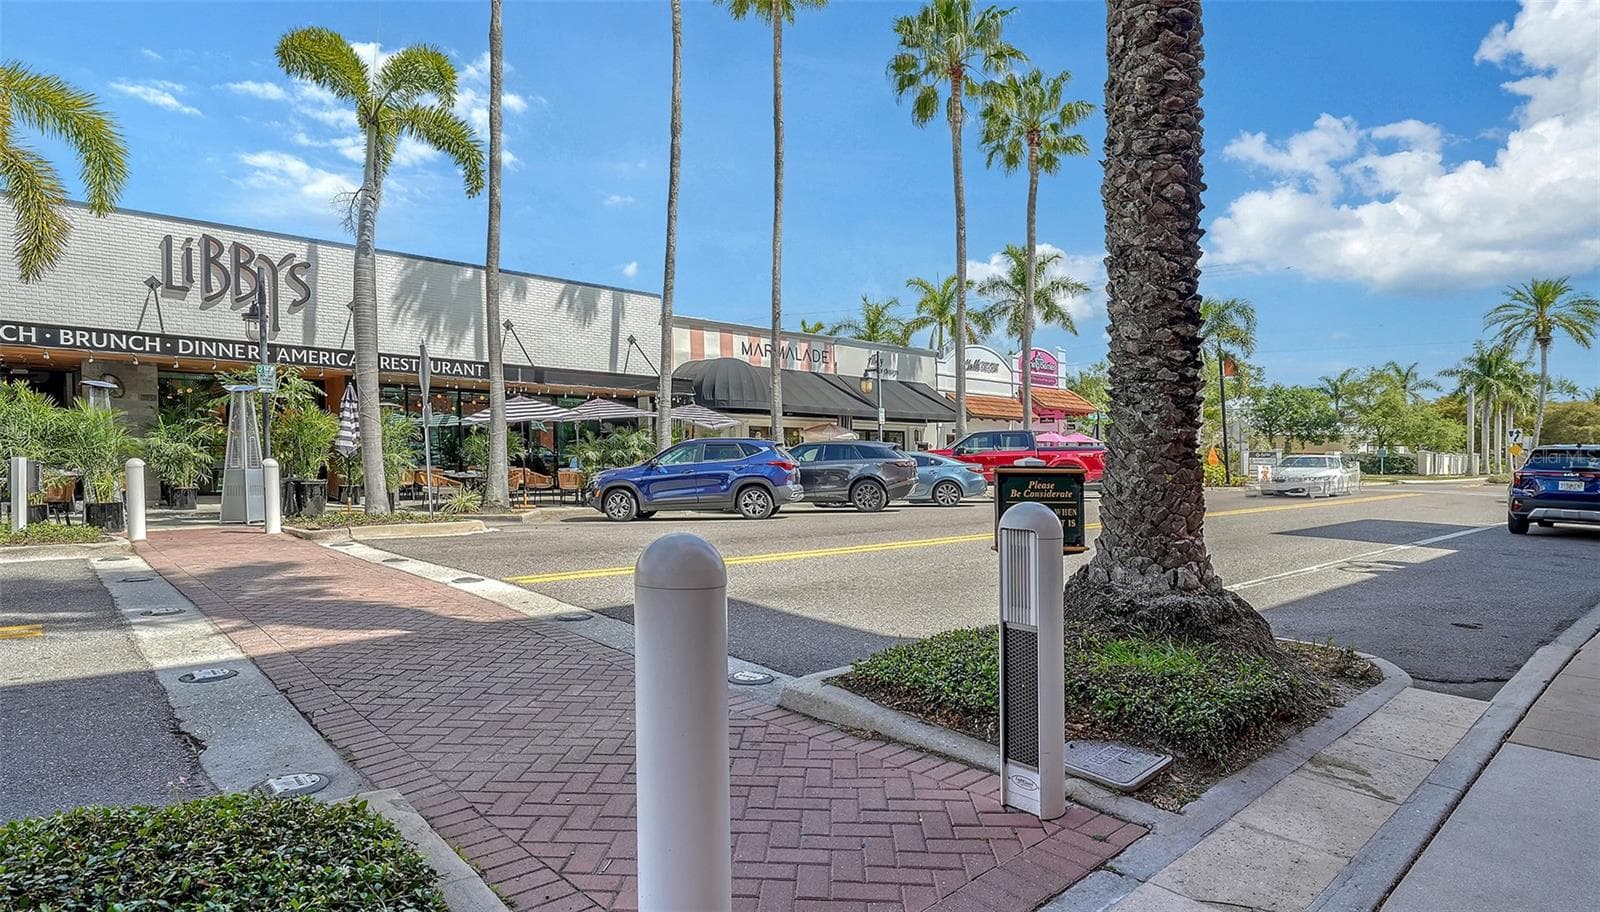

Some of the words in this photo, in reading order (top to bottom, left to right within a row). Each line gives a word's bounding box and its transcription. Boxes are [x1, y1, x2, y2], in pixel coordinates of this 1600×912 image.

[59, 330, 160, 352] BRUNCH
[178, 339, 260, 359] DINNER
[277, 347, 356, 367] AMERICA
[381, 356, 485, 377] RESTURANT
[1028, 480, 1056, 489] Please
[1010, 489, 1022, 498] Be
[1023, 489, 1073, 498] Considerate
[1054, 508, 1077, 516] WHEN
